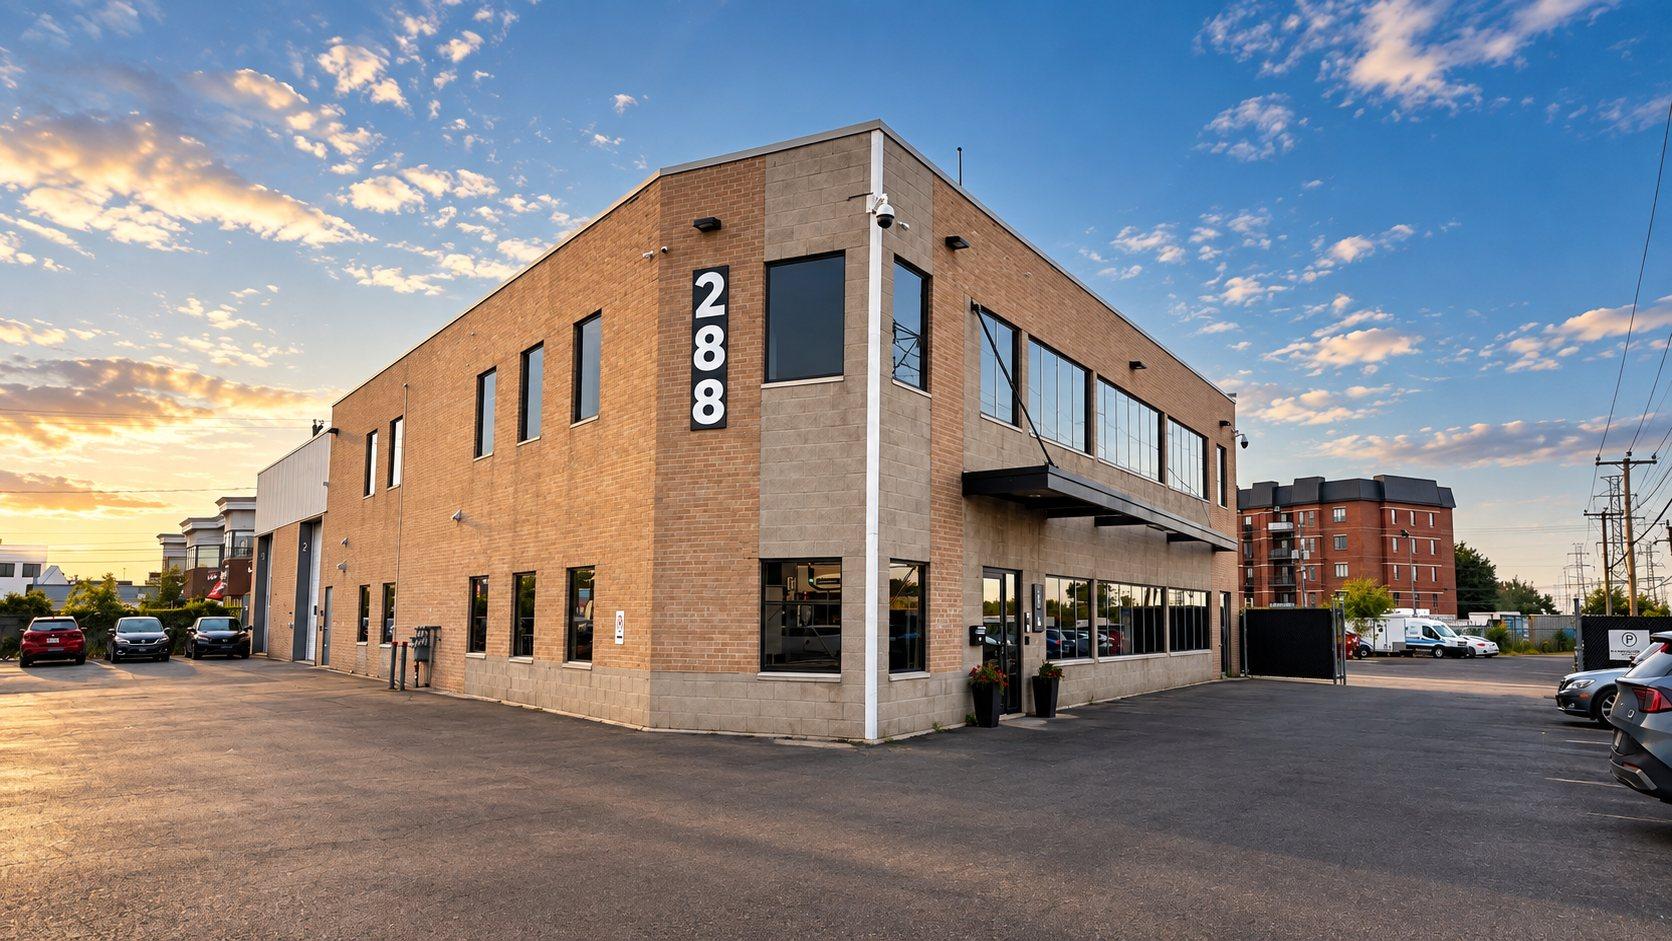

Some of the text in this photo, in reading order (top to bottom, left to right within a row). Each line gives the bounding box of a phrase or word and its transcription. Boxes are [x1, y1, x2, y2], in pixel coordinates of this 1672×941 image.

[692, 271, 726, 425] 288
[302, 542, 308, 552] 2
[1625, 634, 1634, 645] P
